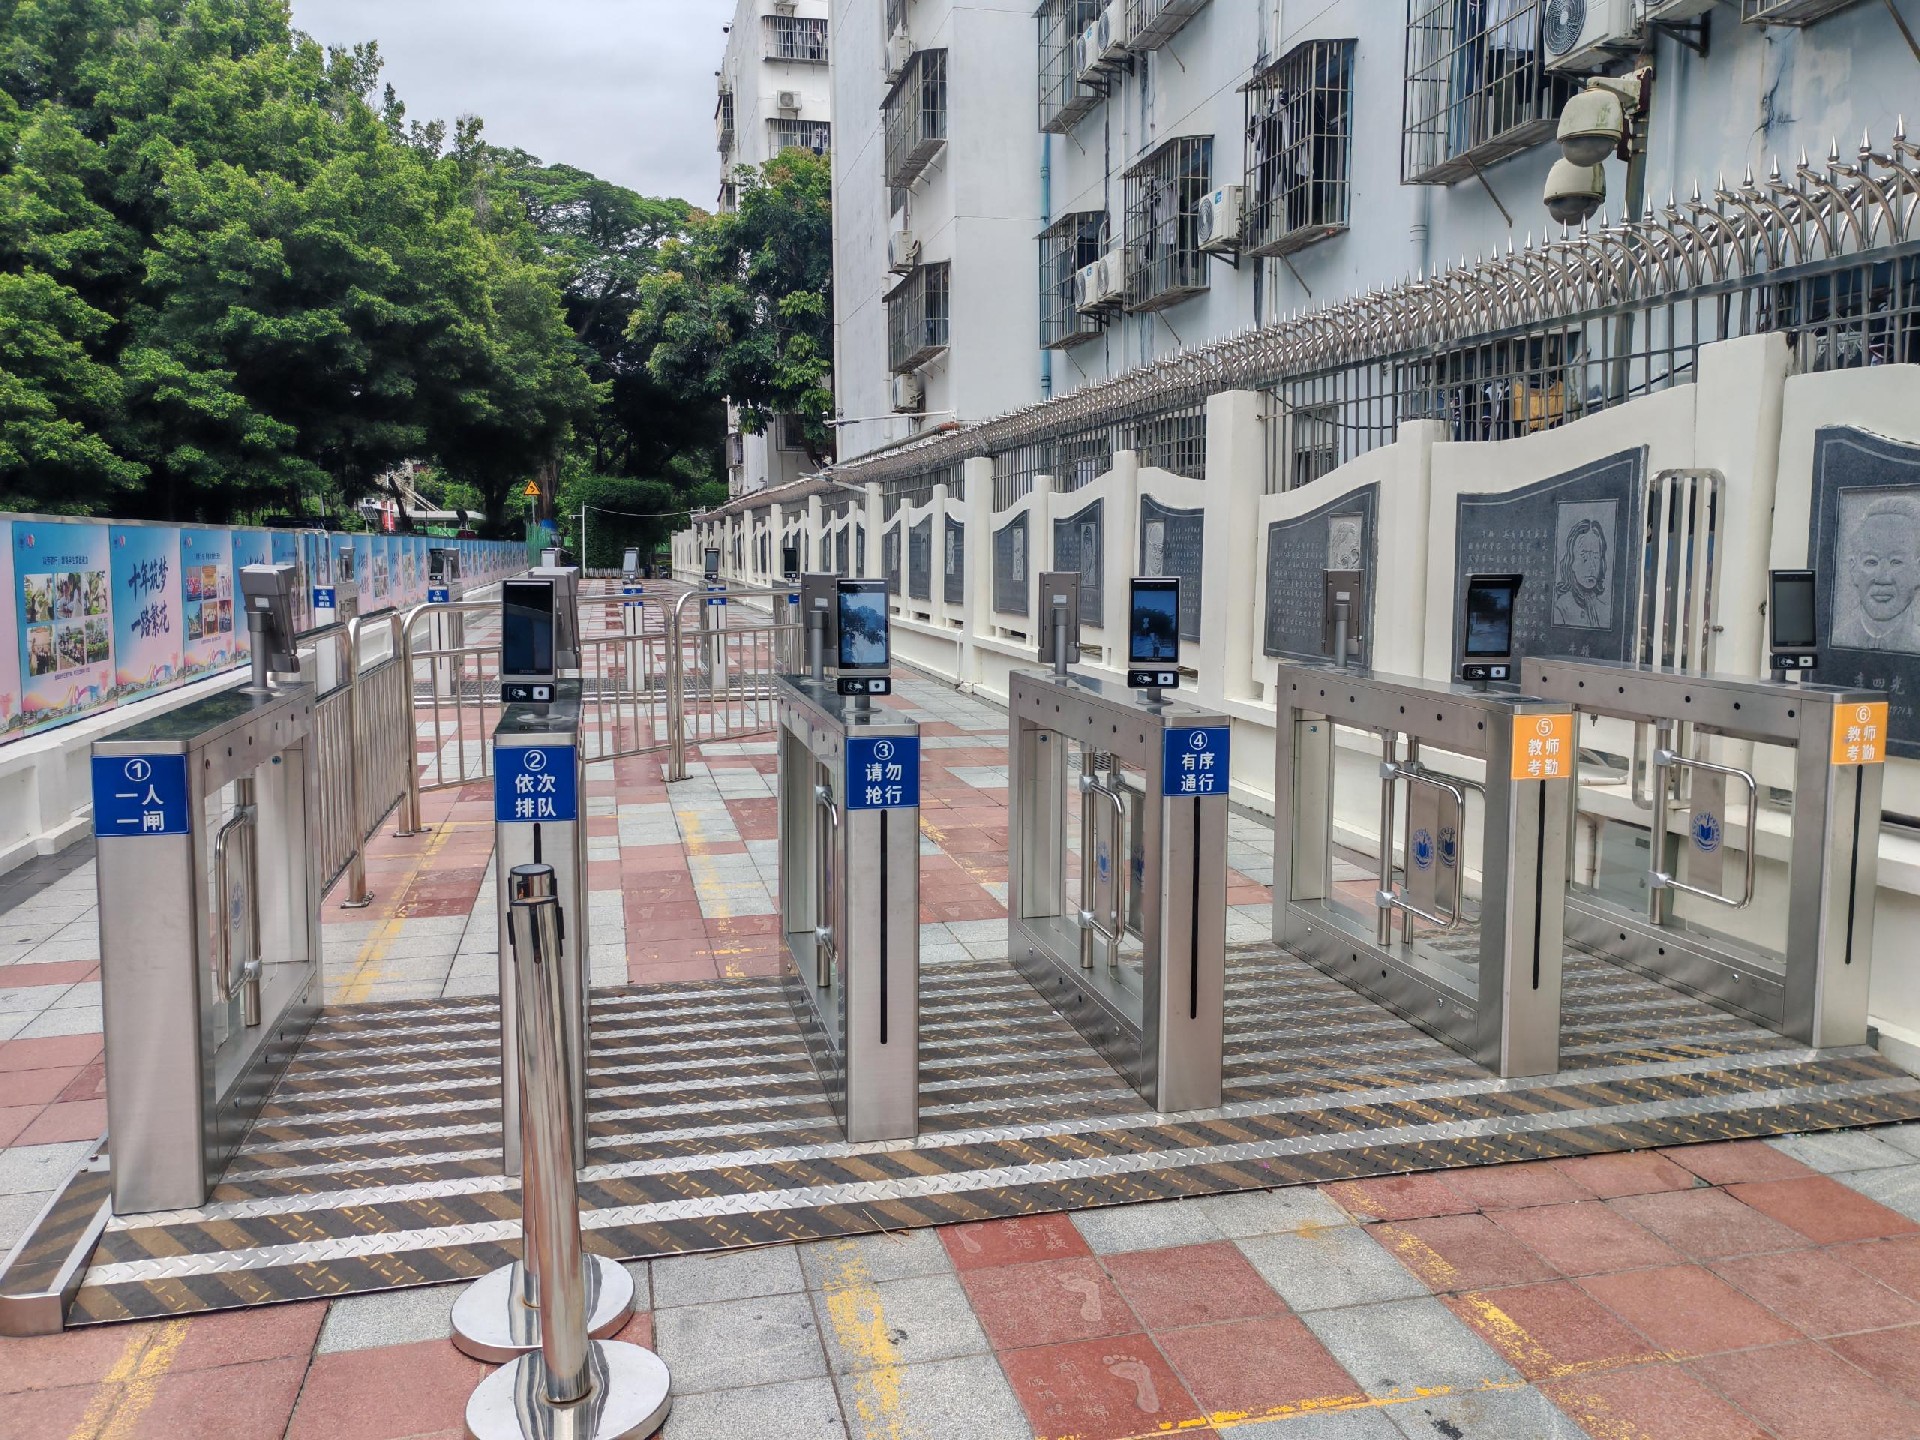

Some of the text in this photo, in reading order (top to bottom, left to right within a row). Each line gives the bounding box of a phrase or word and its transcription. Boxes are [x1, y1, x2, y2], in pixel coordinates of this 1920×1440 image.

[128, 555, 169, 602] 十年筑梦
[131, 600, 170, 639] 一路繁花
[1847, 725, 1877, 742] 教师
[1528, 738, 1560, 756] 教师
[1846, 744, 1876, 761] 考勤
[1181, 751, 1216, 771] 有序
[1527, 758, 1559, 776] 考勤
[865, 761, 903, 782] 请勿
[514, 773, 556, 794] 依次
[1180, 773, 1215, 793] 通行
[115, 783, 164, 806] 一人
[865, 785, 903, 805] 抢行
[515, 797, 557, 818] 排队
[116, 809, 165, 832] 一闸
